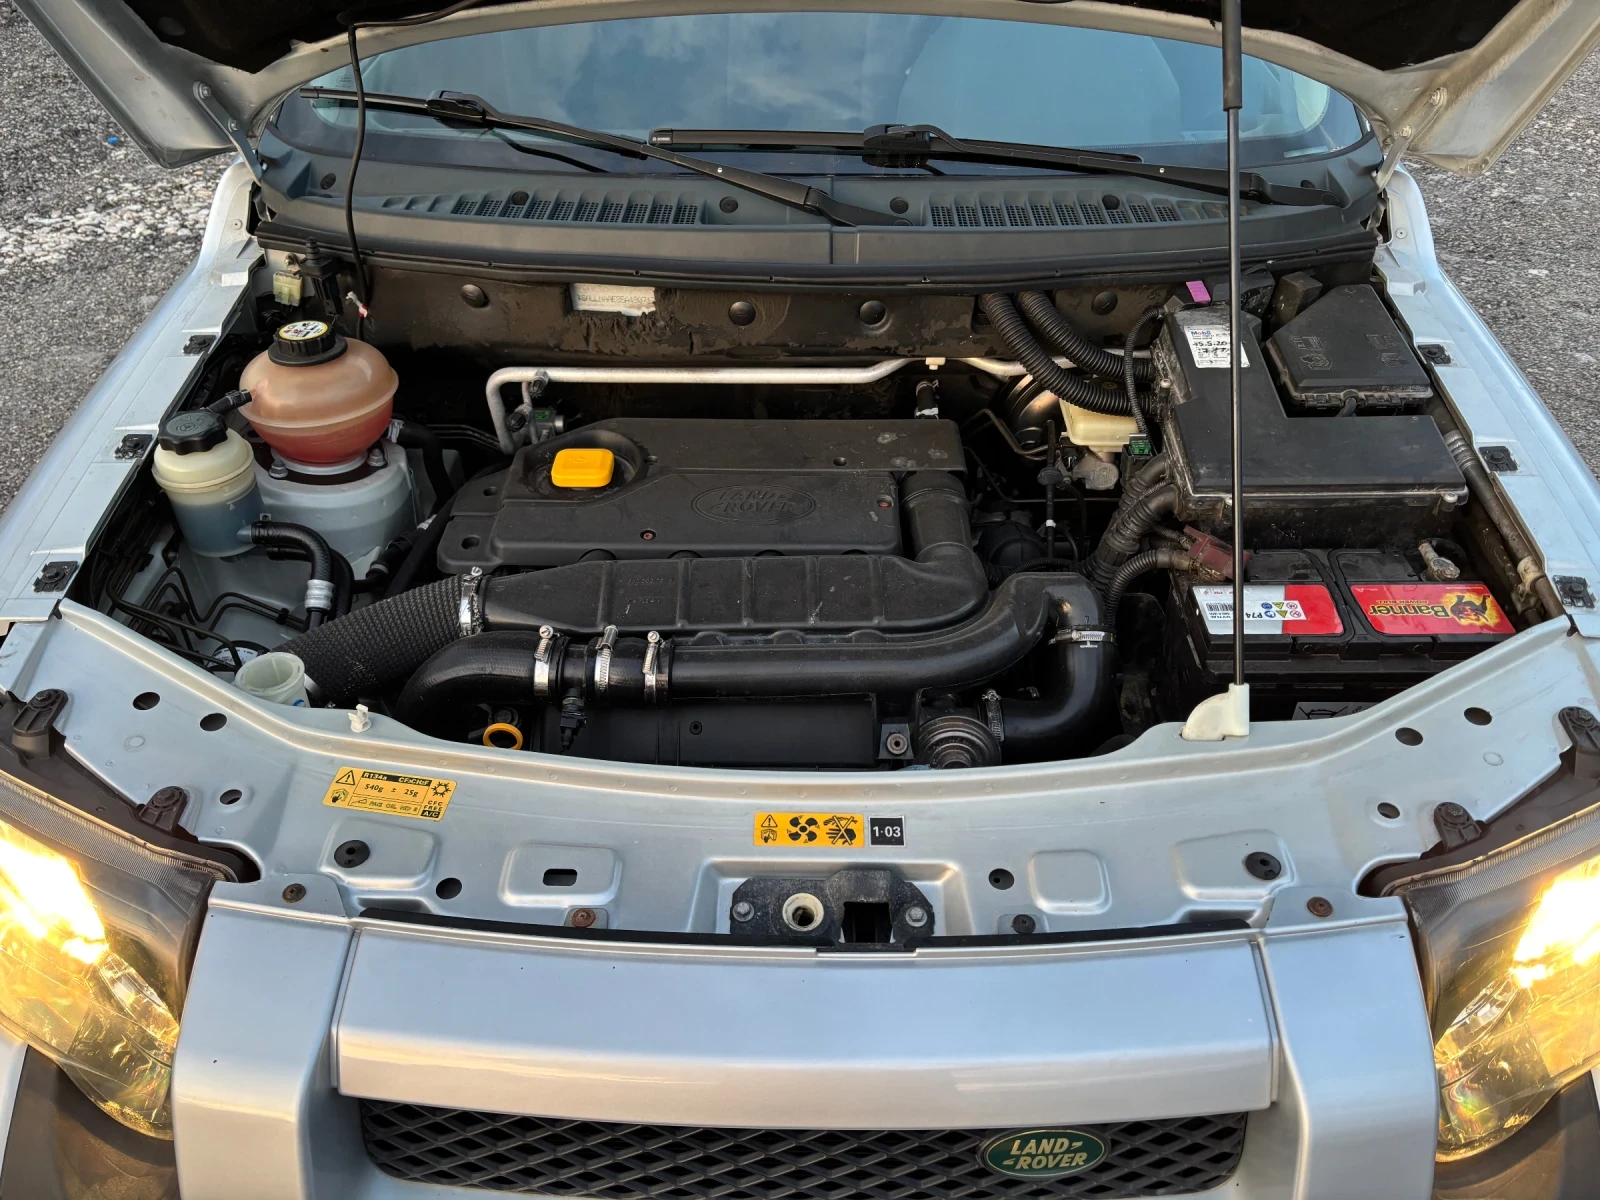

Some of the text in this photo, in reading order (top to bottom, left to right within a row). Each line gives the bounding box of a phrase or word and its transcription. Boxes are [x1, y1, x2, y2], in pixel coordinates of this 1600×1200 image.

[718, 490, 779, 500] LAND
[723, 501, 796, 513] ROVER
[1369, 605, 1451, 619] Banner
[363, 772, 387, 781] R134a
[364, 783, 384, 793] 540g
[403, 788, 419, 798] 25g
[1010, 1137, 1070, 1155] LAND
[1014, 1152, 1088, 1170] ROVER
